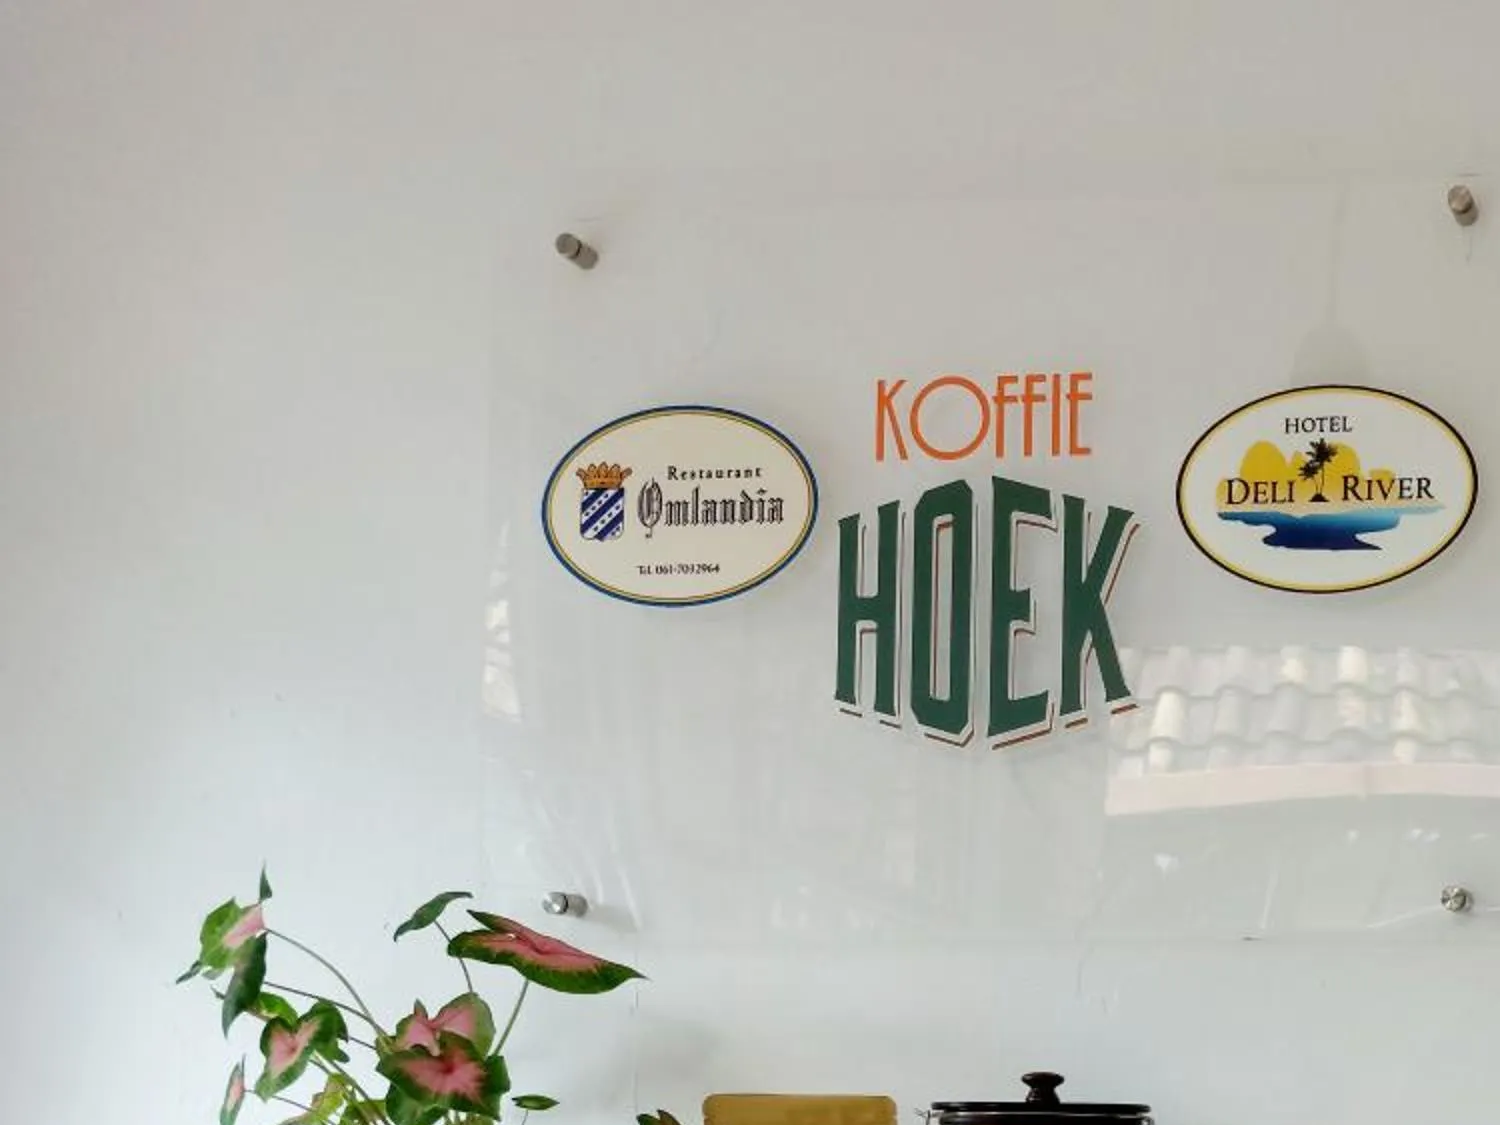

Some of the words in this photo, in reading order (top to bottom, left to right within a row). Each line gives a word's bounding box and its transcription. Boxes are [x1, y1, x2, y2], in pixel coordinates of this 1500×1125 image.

[875, 372, 1093, 462] KOFFIE
[1284, 416, 1353, 434] HOTEL
[667, 465, 763, 481] Restaurant
[1225, 477, 1295, 505] DELI
[1342, 474, 1435, 502] RIVER
[835, 475, 1139, 749] HOEK
